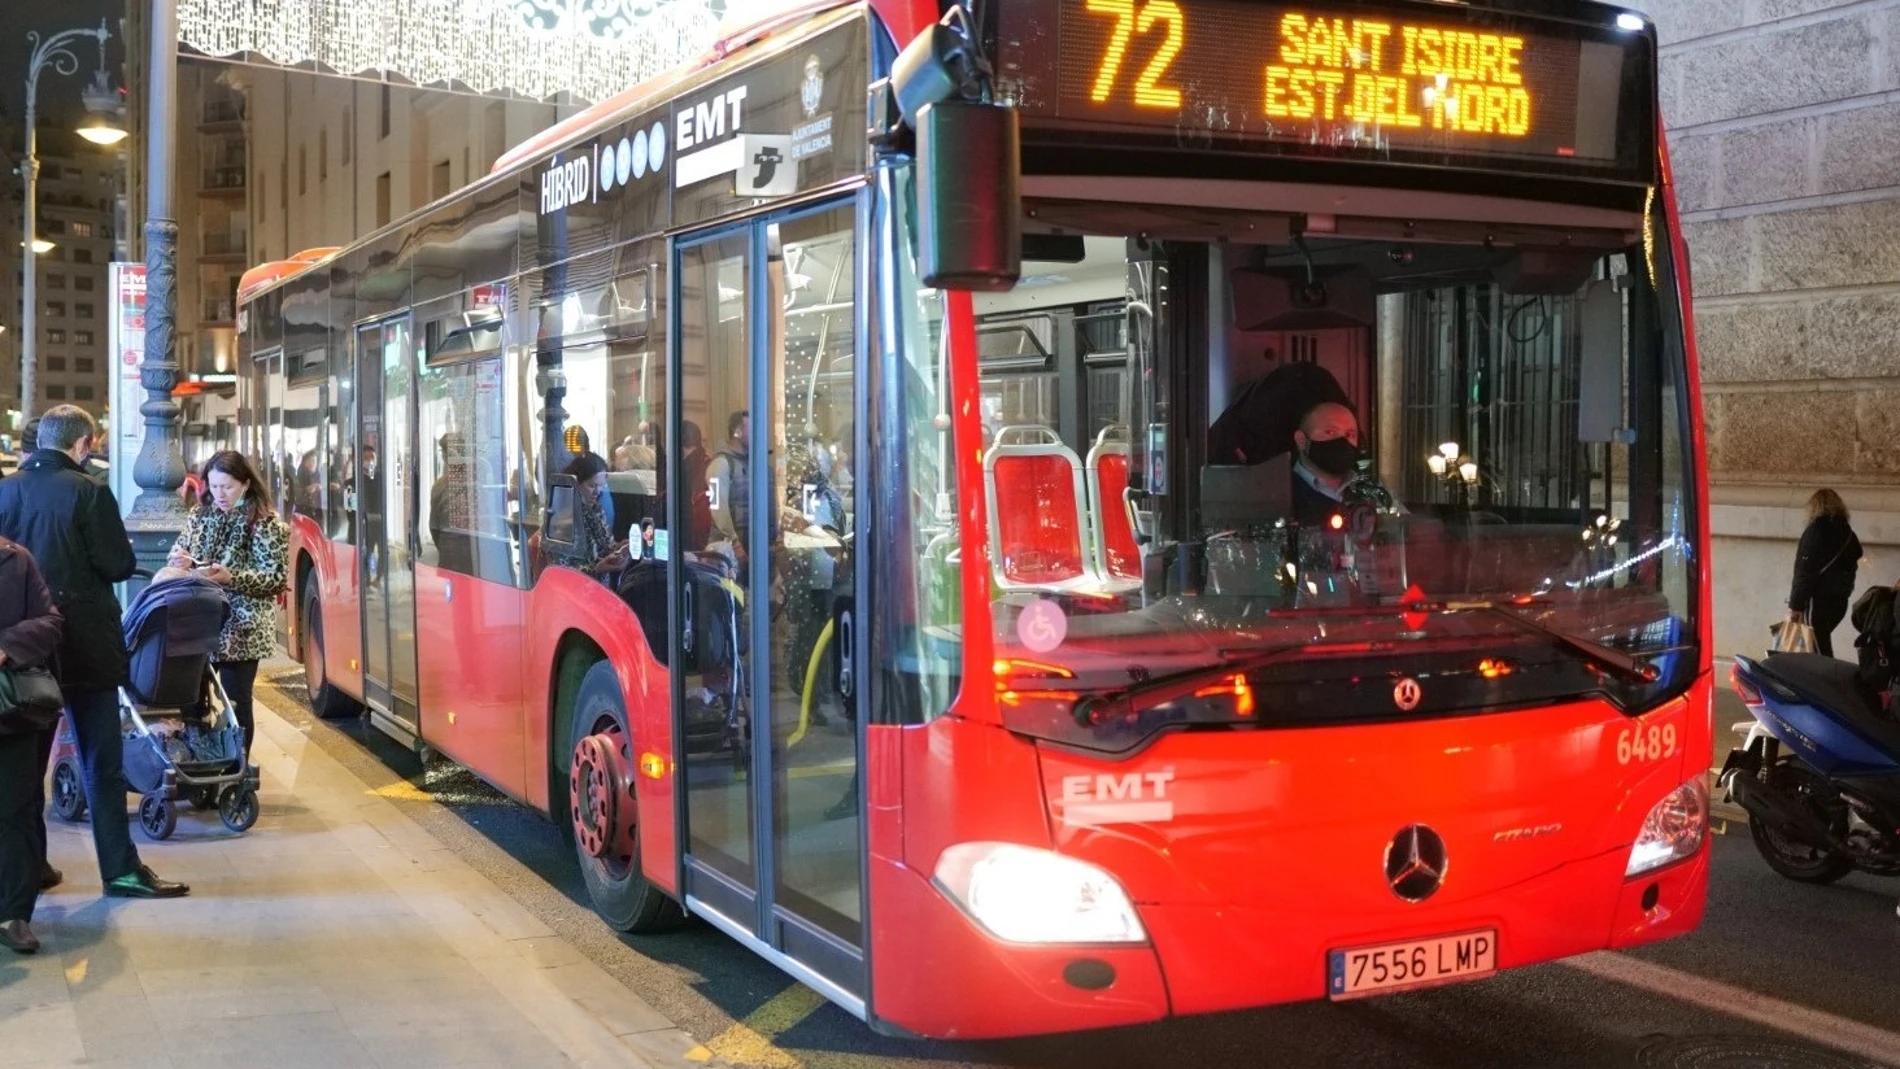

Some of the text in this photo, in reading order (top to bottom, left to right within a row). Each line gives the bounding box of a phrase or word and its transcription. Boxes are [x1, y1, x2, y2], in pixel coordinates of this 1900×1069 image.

[1085, 0, 1183, 107] 72
[1280, 13, 1524, 85] SANT ISIDRE
[676, 84, 747, 151] EMT
[1432, 83, 1529, 136] NORD
[541, 155, 589, 215] HÍBRID
[120, 274, 146, 284] EM
[1617, 723, 1676, 765] 6489
[1063, 771, 1175, 801] EMT
[1353, 937, 1488, 987] 7556 LMP
